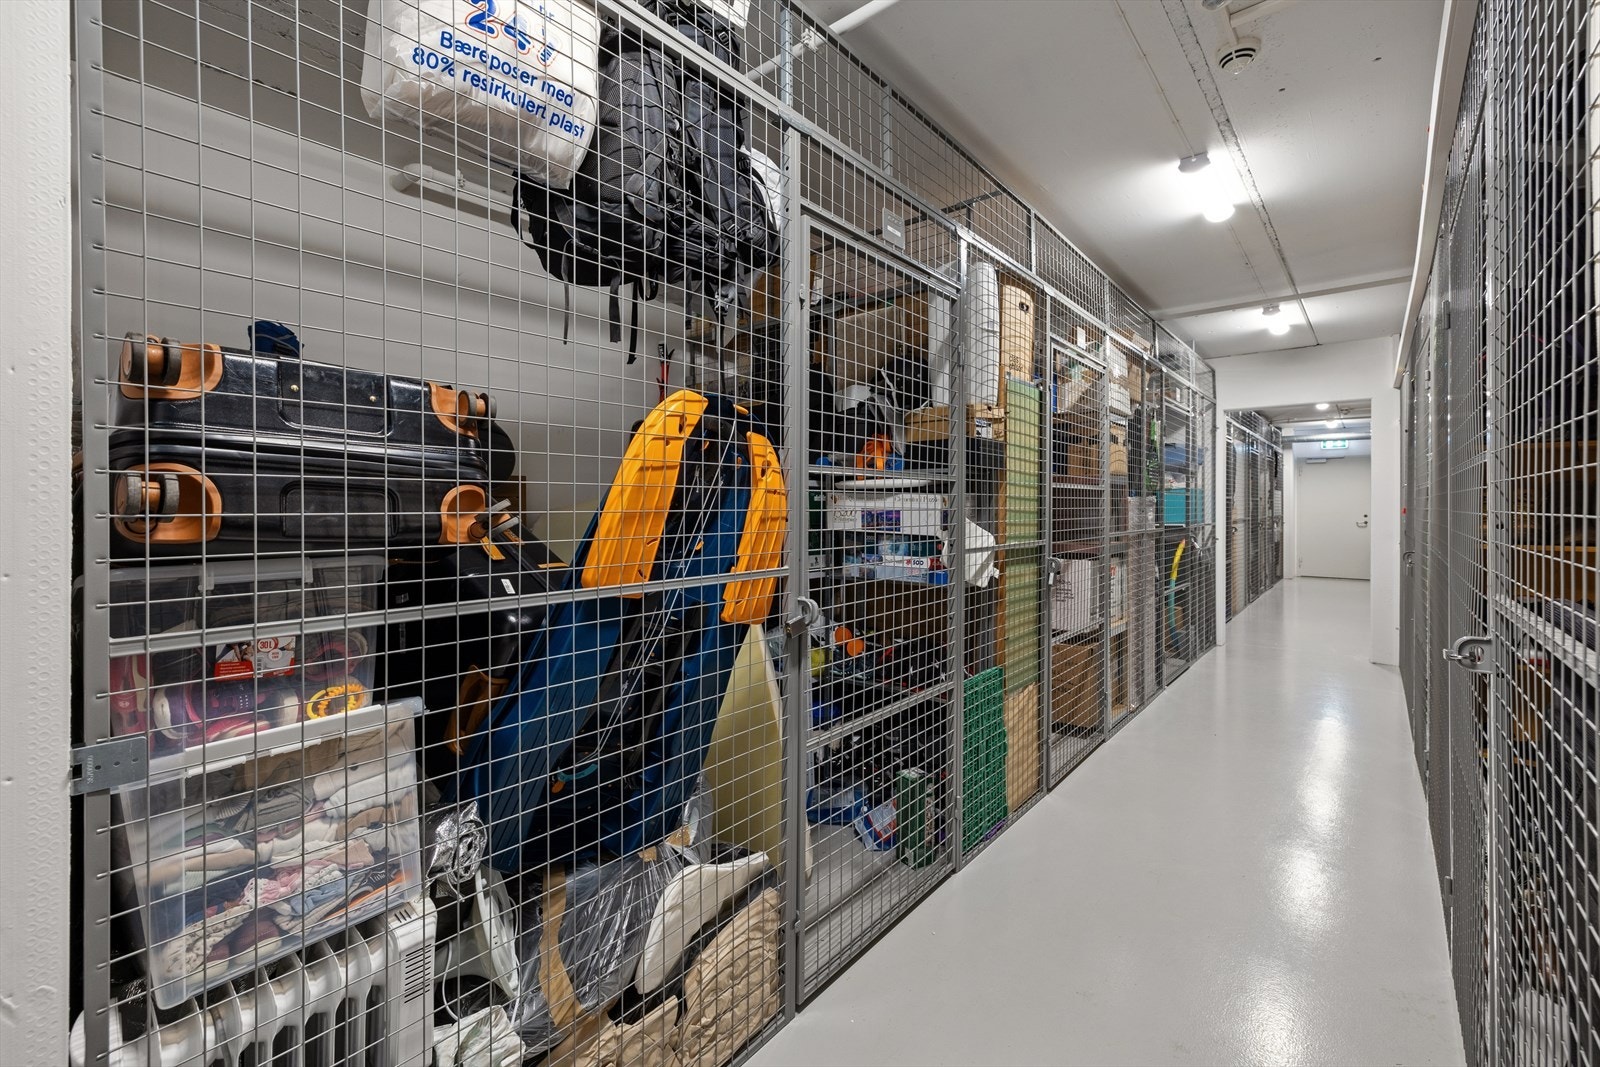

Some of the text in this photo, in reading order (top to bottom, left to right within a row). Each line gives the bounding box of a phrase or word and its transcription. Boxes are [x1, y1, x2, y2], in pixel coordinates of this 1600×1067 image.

[412, 47, 585, 139] 80% resirkulert plast
[440, 31, 576, 108] Bæreposer med
